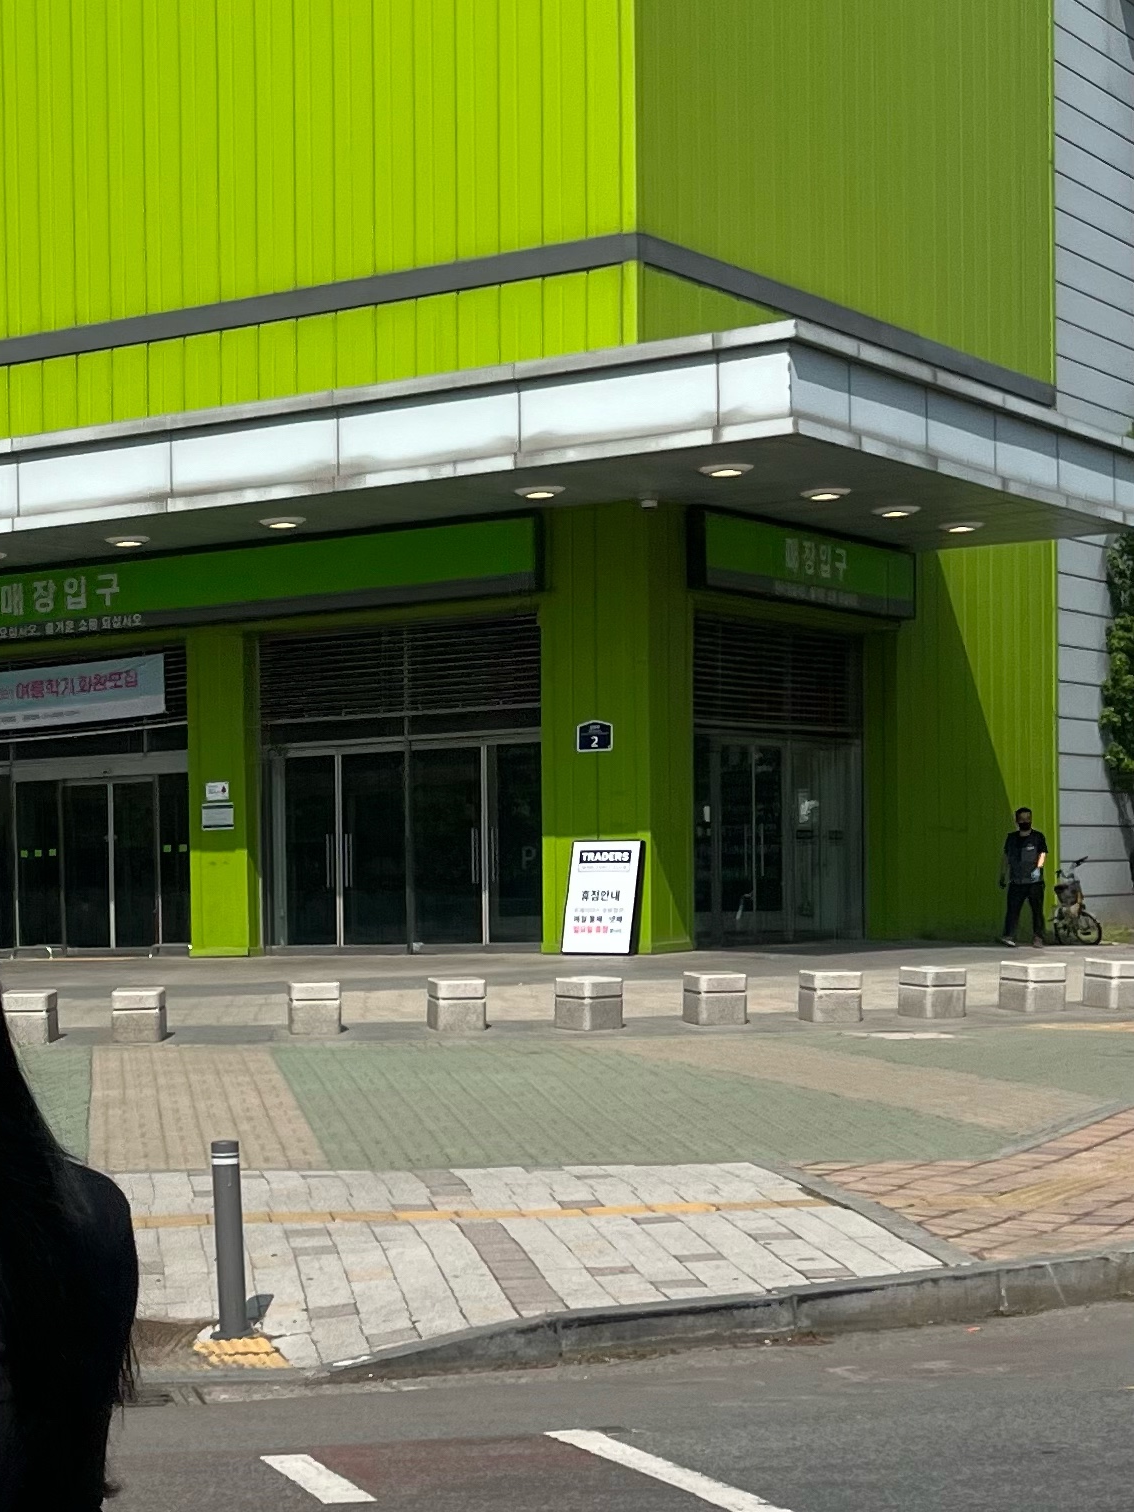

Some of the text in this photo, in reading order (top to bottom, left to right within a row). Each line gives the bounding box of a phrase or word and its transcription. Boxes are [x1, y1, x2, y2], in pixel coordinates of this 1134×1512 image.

[786, 538, 847, 581] 매장입구
[0, 573, 120, 616] 매장입구
[16, 677, 74, 699] 여름학기
[590, 735, 599, 748] 2
[581, 851, 630, 862] TRADERS
[581, 890, 621, 902] 휴점안내
